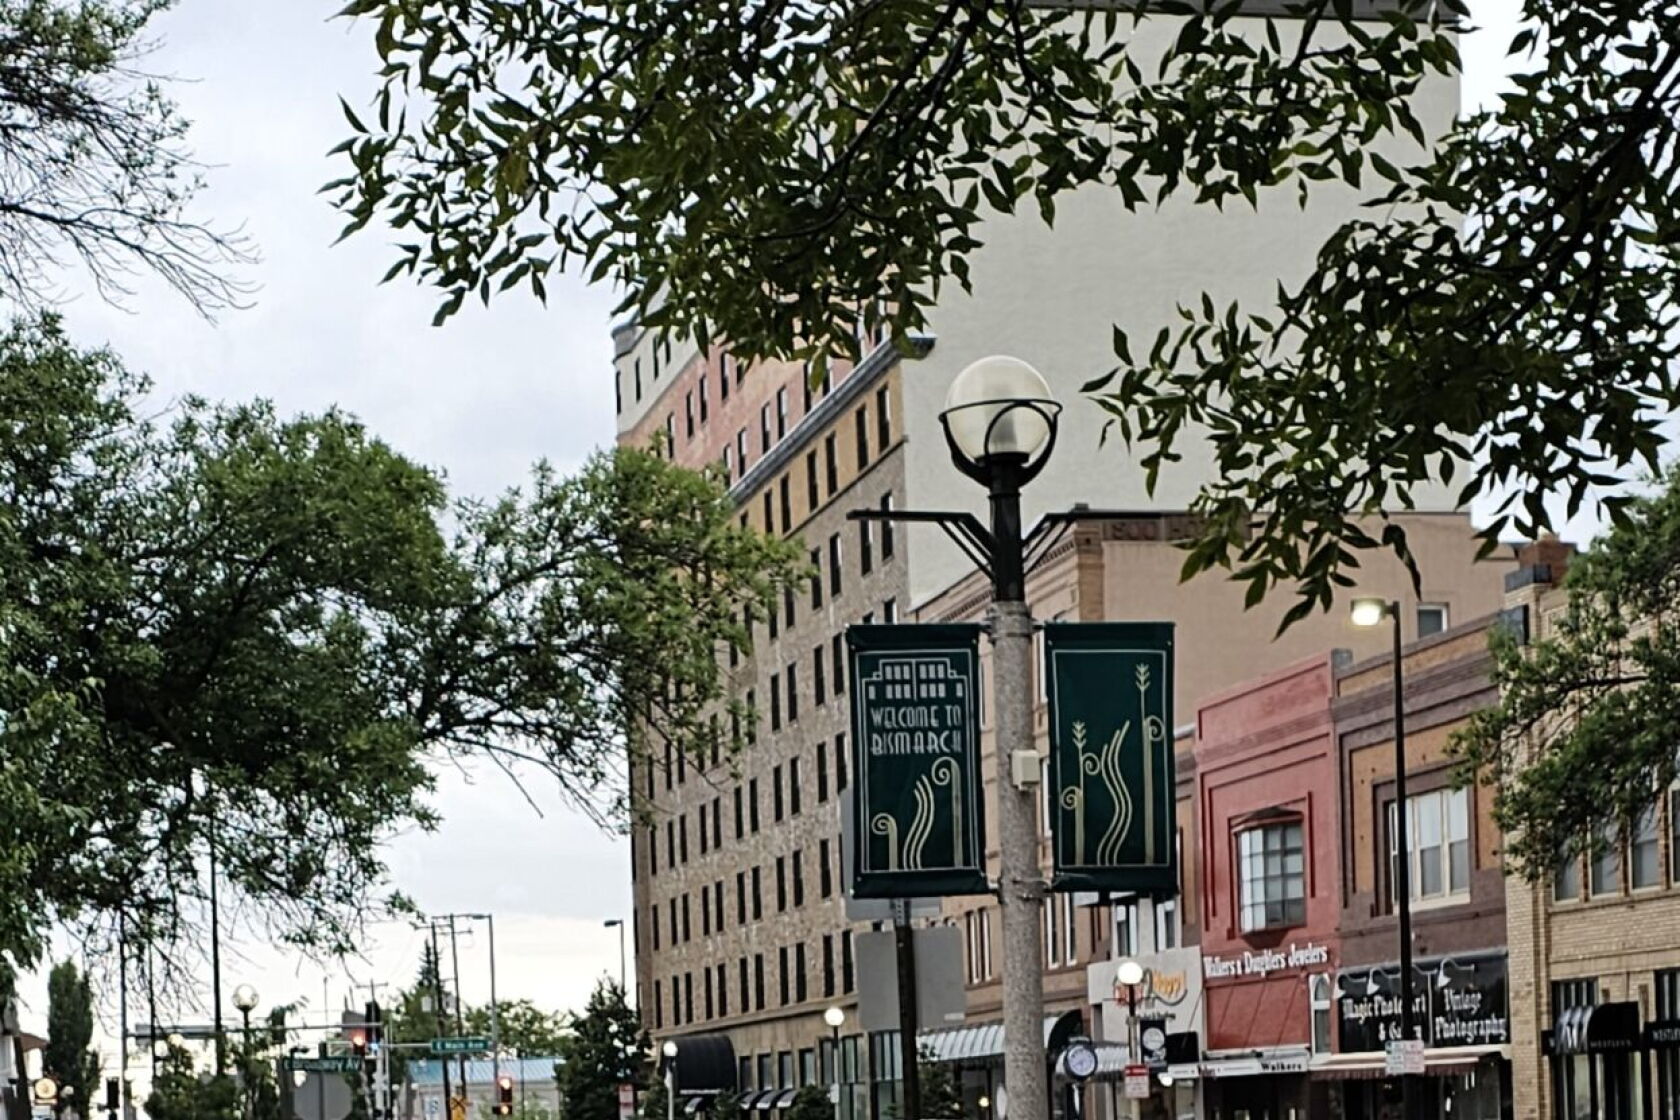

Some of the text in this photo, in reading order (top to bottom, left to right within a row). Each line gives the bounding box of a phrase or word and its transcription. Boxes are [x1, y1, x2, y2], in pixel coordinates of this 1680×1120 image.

[870, 704, 962, 729] WELCOME TO
[870, 730, 962, 756] BISMARCK
[1435, 1012, 1507, 1043] Photography
